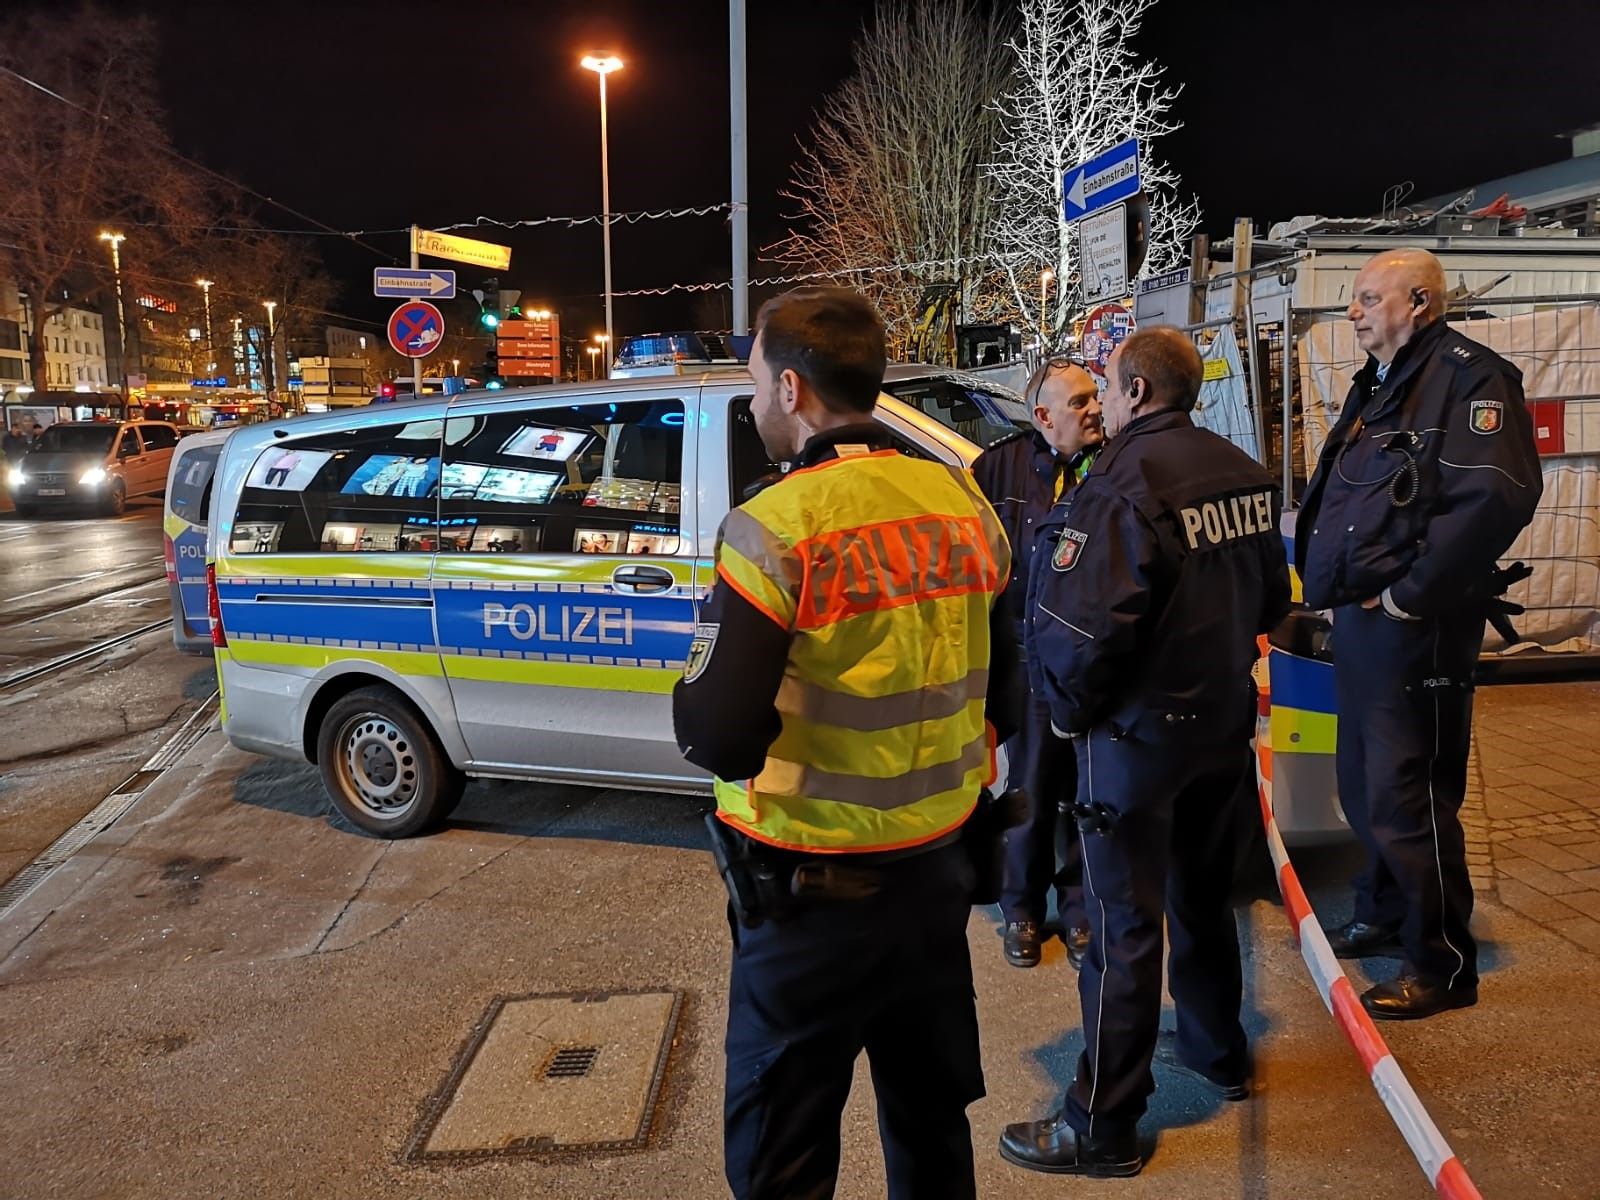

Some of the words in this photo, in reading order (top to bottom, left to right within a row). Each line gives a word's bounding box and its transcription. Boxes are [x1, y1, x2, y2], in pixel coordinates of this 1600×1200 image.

[1083, 162, 1134, 195] Einbahnstraße
[380, 278, 432, 289] Einbahnstraße
[1180, 491, 1273, 549] POLIZEI
[179, 545, 206, 559] POL
[808, 518, 988, 615] POLIZEI
[483, 602, 633, 646] POLIZEI
